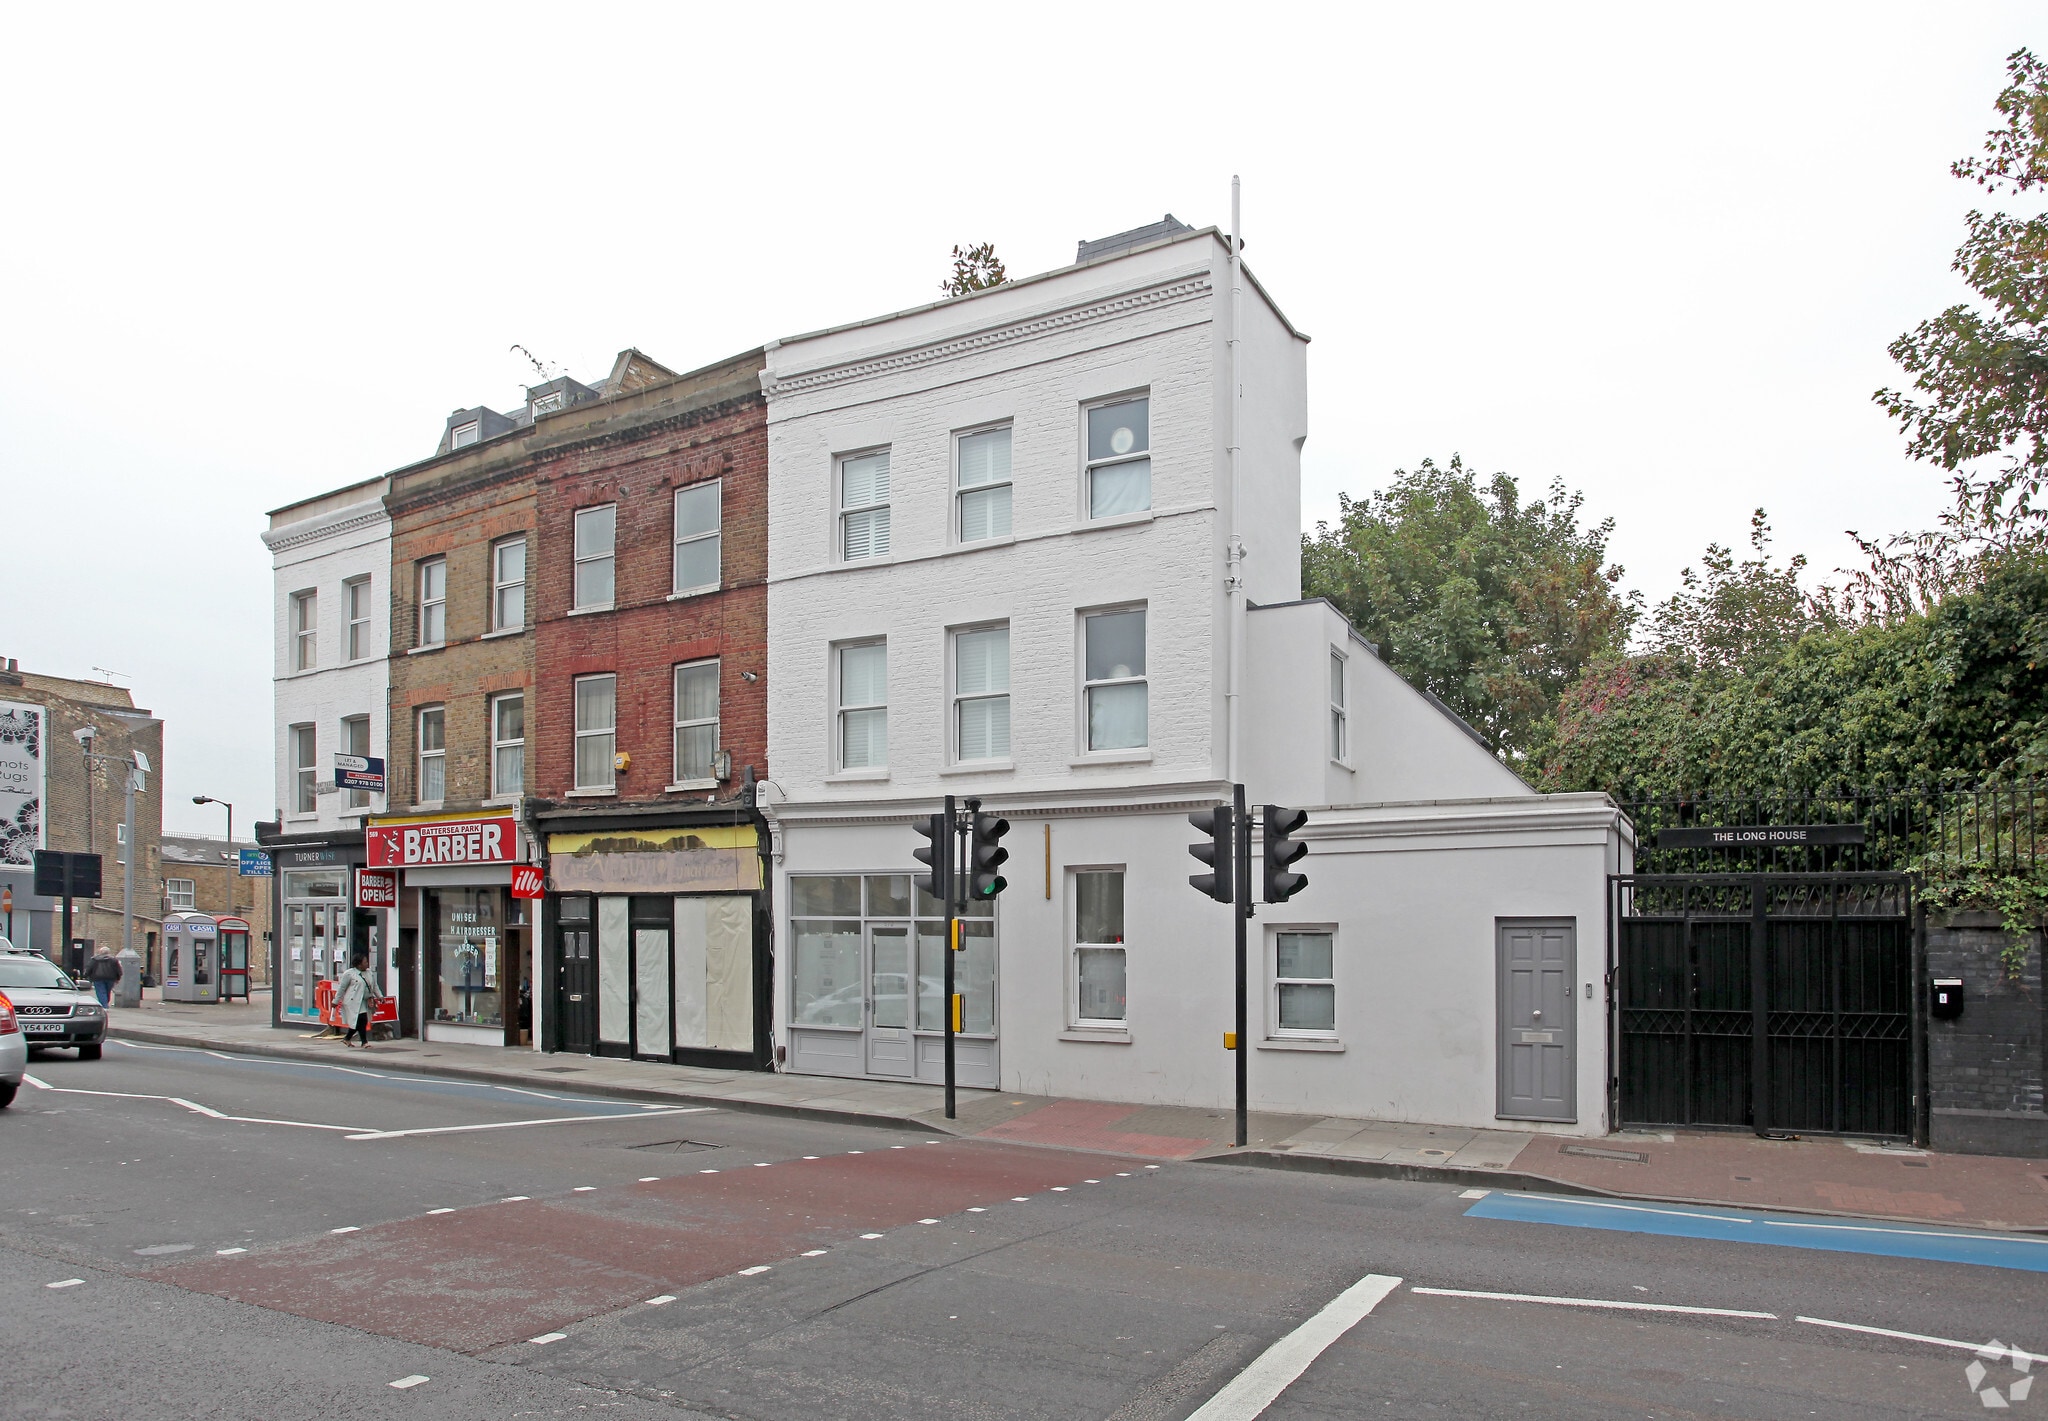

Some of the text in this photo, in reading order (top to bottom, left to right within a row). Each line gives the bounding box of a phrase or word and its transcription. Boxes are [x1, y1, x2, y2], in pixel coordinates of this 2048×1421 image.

[421, 824, 480, 836] BATTERSEA PARK
[1713, 830, 1807, 842] THE LONG HOUSE
[404, 823, 503, 864] BARBER
[362, 874, 385, 888] BARBER
[514, 870, 543, 897] illy
[362, 889, 385, 903] OPEN
[451, 912, 477, 923] UNISEX
[166, 923, 181, 931] CASH
[191, 924, 213, 933] CASH
[450, 926, 496, 936] HAIRDRESSER
[453, 944, 479, 958] BARBER
